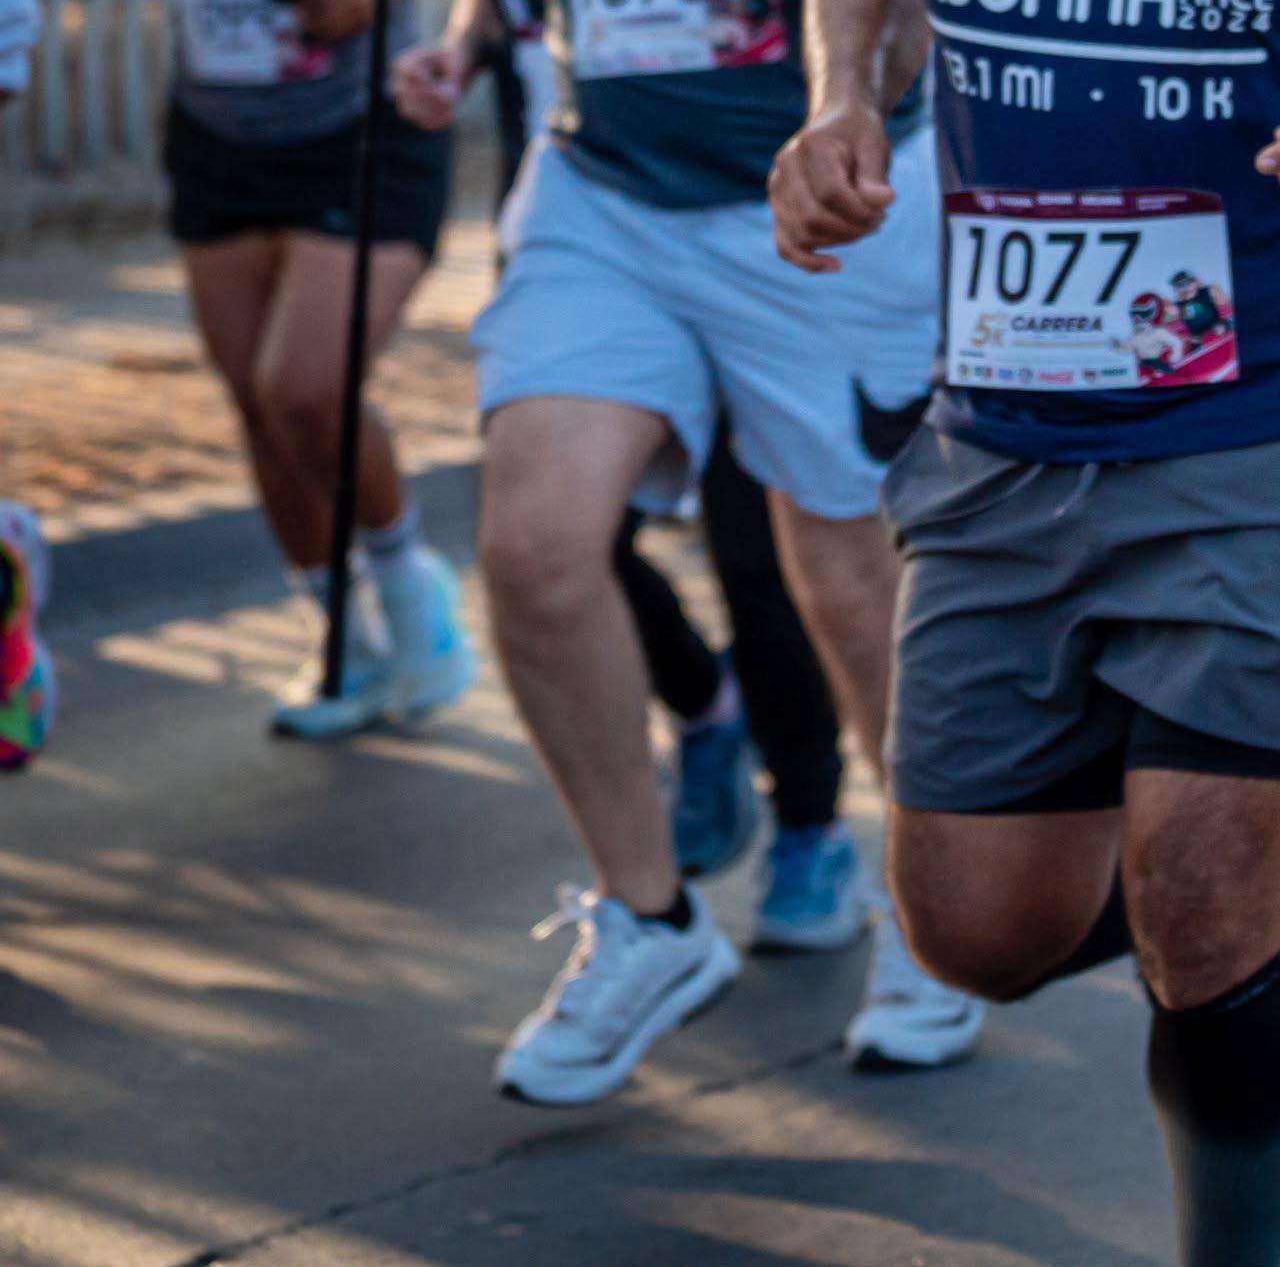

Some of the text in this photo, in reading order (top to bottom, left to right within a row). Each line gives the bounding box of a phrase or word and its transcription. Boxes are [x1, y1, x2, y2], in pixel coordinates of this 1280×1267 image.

[1000, 62, 1055, 112] MI
[1138, 75, 1190, 121] 10
[1203, 76, 1235, 121] K
[966, 226, 1142, 306] 1077
[1010, 315, 1103, 333] CARRERA
